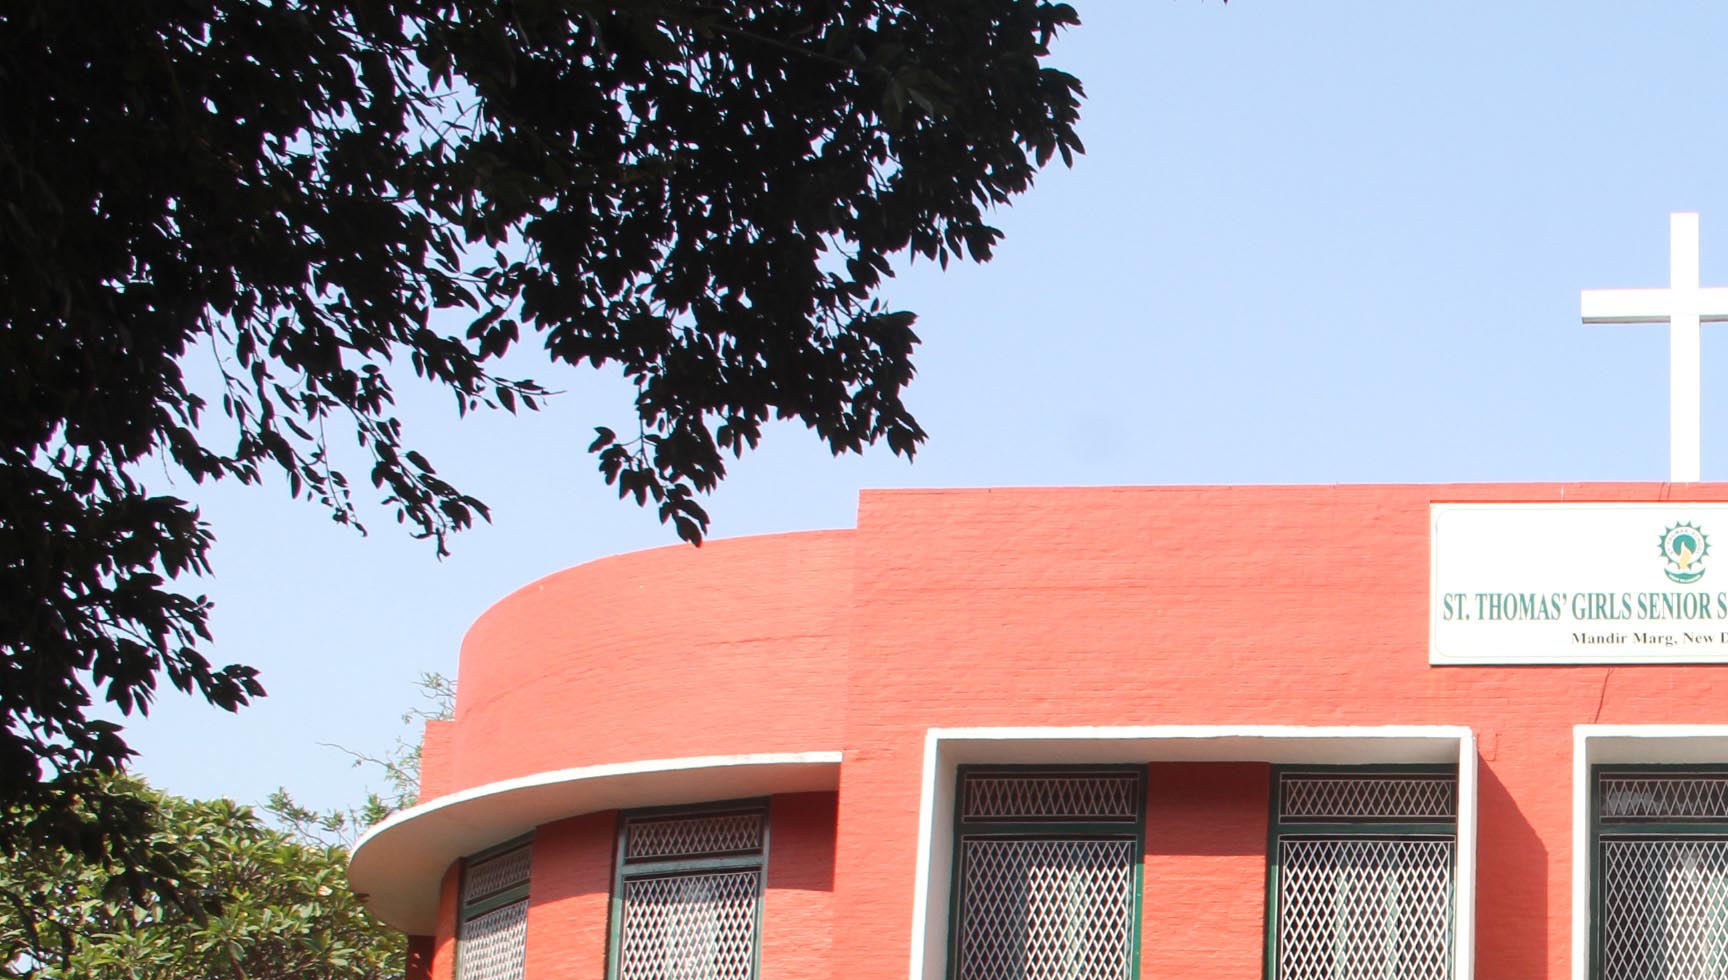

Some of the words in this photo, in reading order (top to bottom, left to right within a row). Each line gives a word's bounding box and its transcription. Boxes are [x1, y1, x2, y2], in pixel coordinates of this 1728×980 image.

[1442, 592, 1471, 621] ST.
[1571, 592, 1633, 620] GIRLS
[1636, 591, 1713, 620] SENIOR
[1571, 632, 1628, 645] Mandir
[1633, 632, 1678, 648] Marg,
[1683, 631, 1714, 644] New
